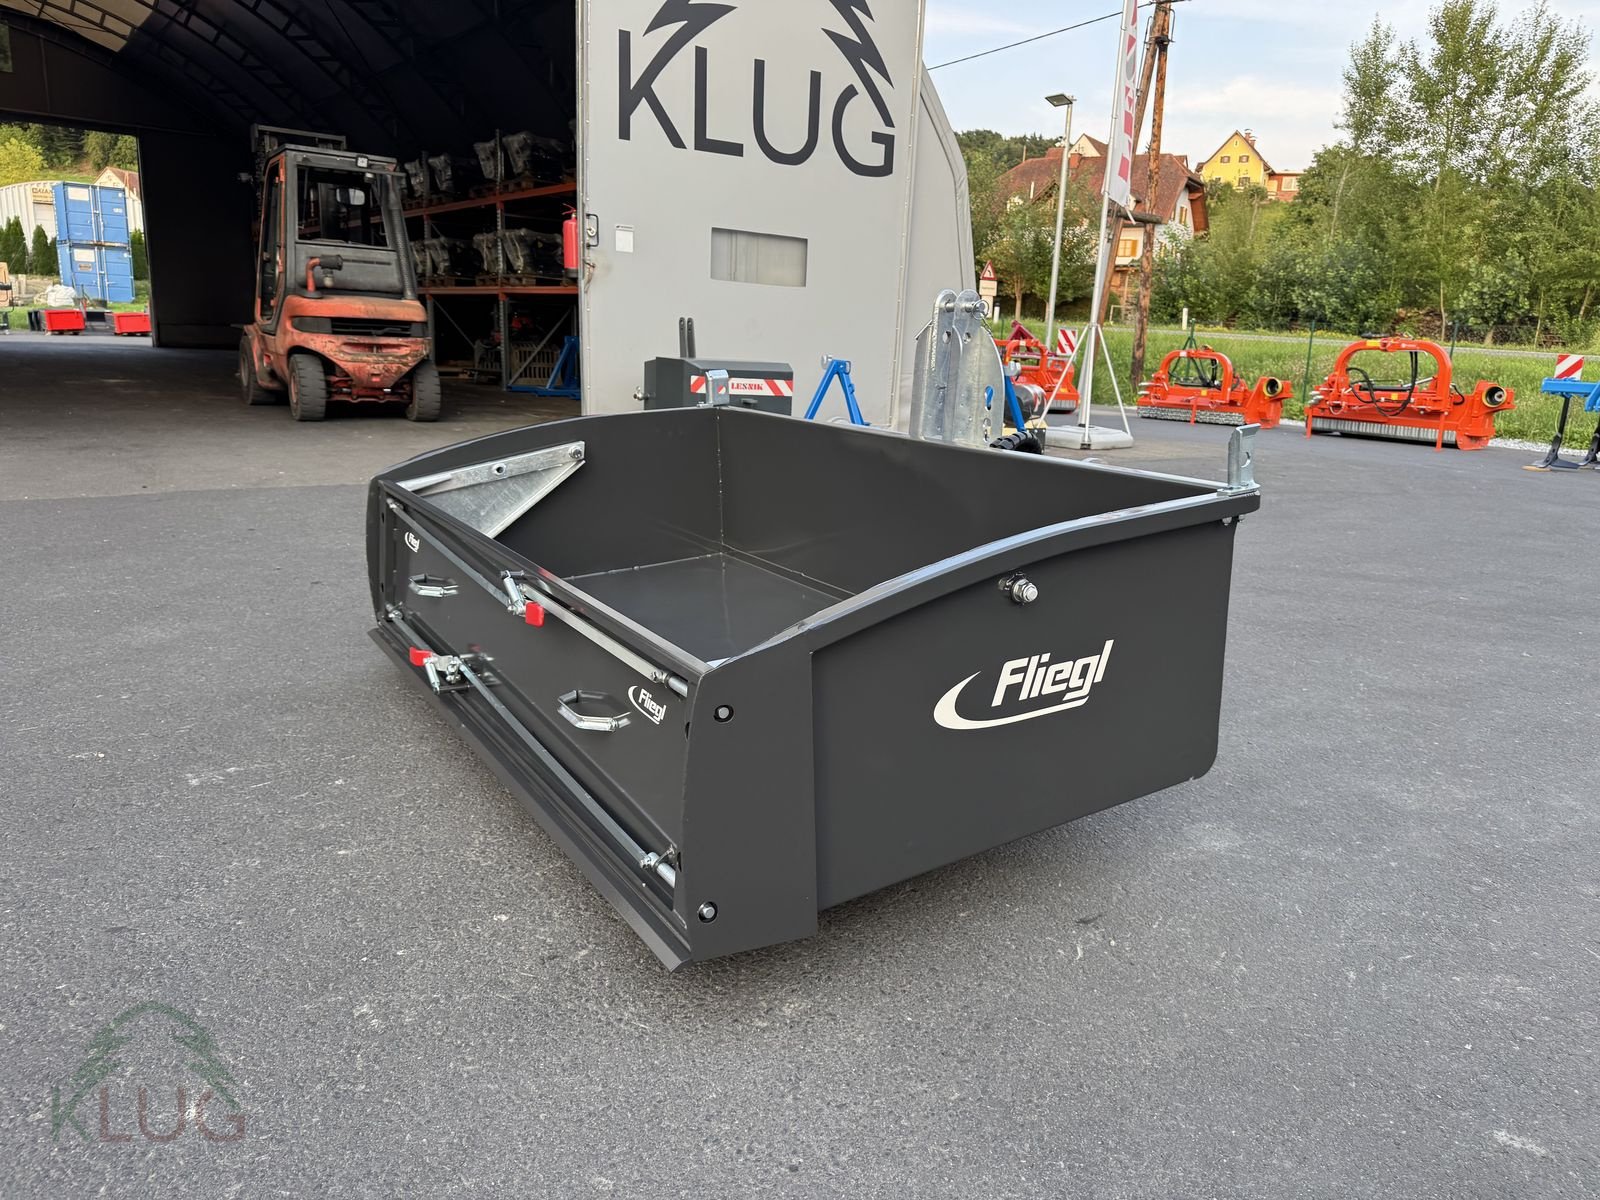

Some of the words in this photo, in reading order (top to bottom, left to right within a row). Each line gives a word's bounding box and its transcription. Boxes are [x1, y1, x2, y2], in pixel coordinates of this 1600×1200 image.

[618, 28, 896, 178] KLUG
[638, 688, 667, 721] Fliegl
[991, 639, 1115, 707] Fliegl
